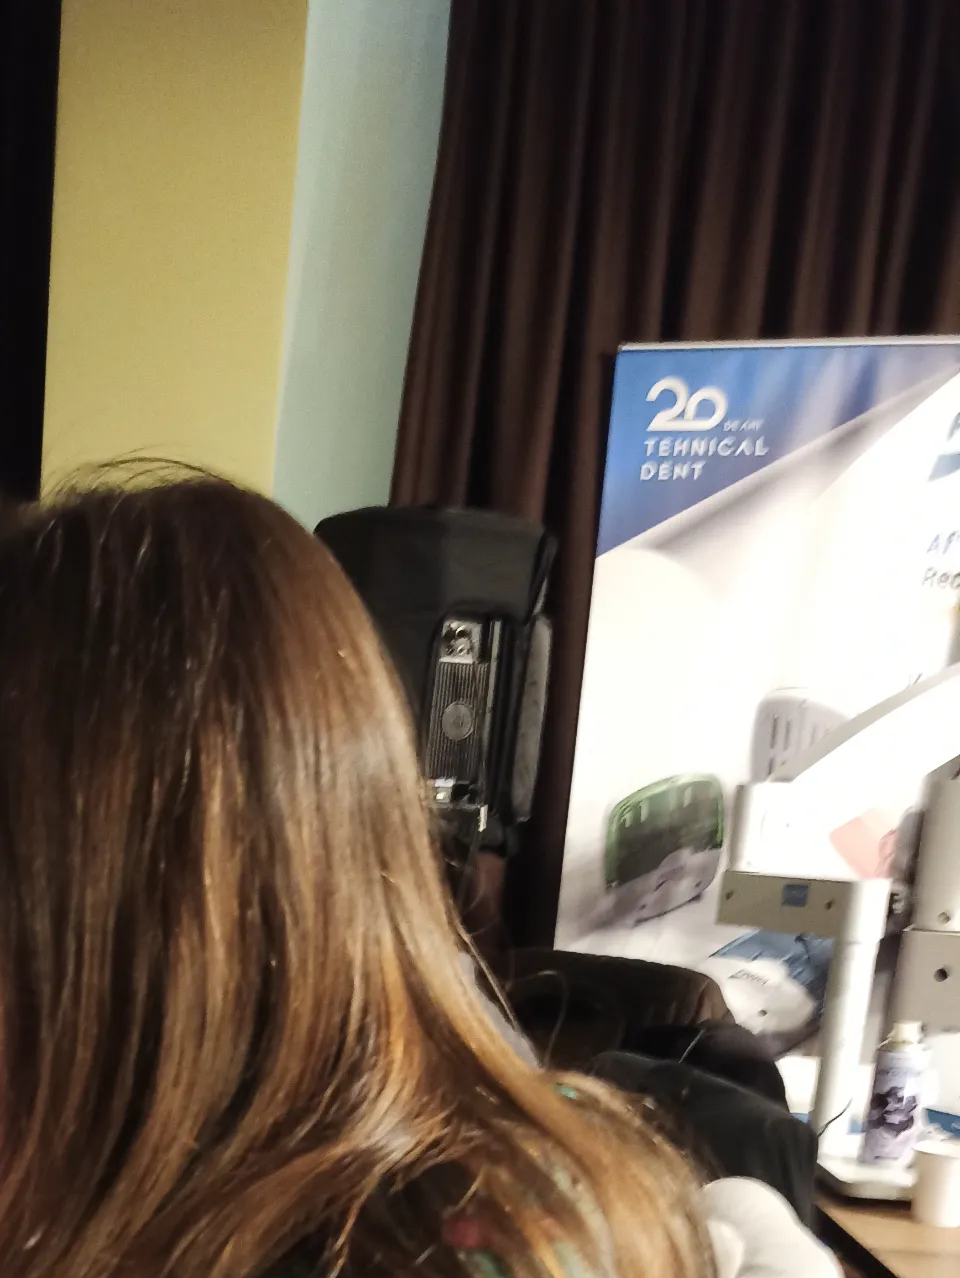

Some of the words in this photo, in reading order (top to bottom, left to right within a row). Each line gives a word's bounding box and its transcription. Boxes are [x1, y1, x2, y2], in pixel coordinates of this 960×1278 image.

[646, 376, 729, 432] 20
[644, 436, 770, 457] TEHNICAL
[640, 460, 706, 481] DENT
